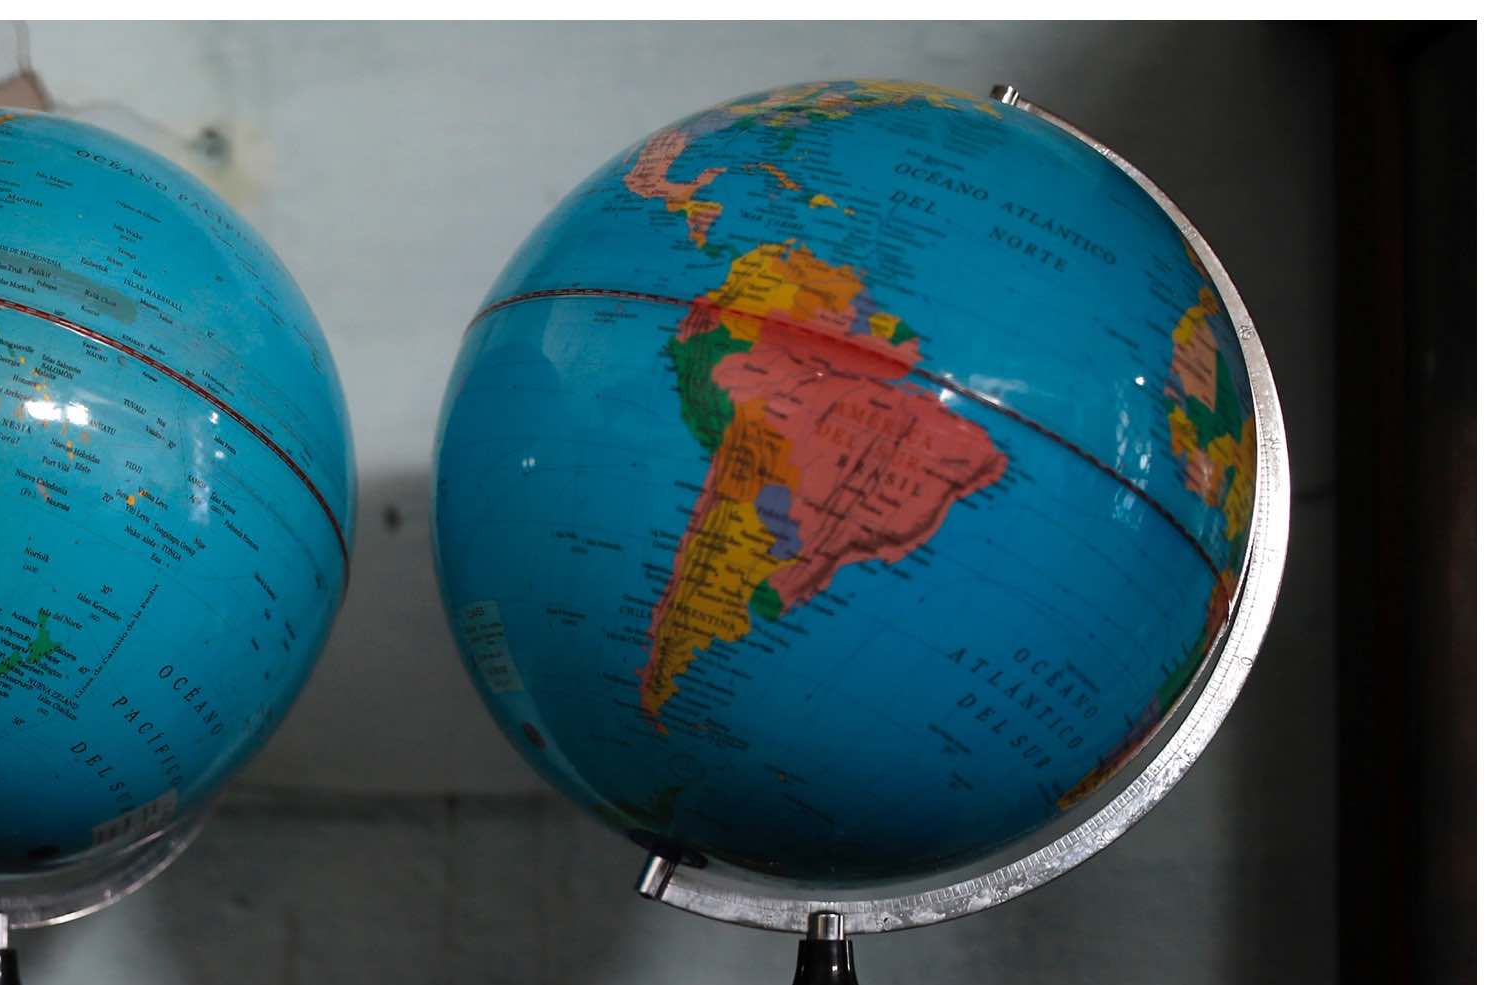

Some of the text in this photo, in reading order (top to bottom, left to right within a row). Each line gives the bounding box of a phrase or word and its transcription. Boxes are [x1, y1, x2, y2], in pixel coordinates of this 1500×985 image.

[888, 189, 1070, 273] DEL NORTE
[894, 162, 1119, 266] OCÉANO ATLÁNTICO
[158, 663, 226, 737] OCÉANO
[957, 692, 1008, 735] DEL
[70, 740, 114, 779] DEL
[111, 694, 186, 788] PACÍFICO
